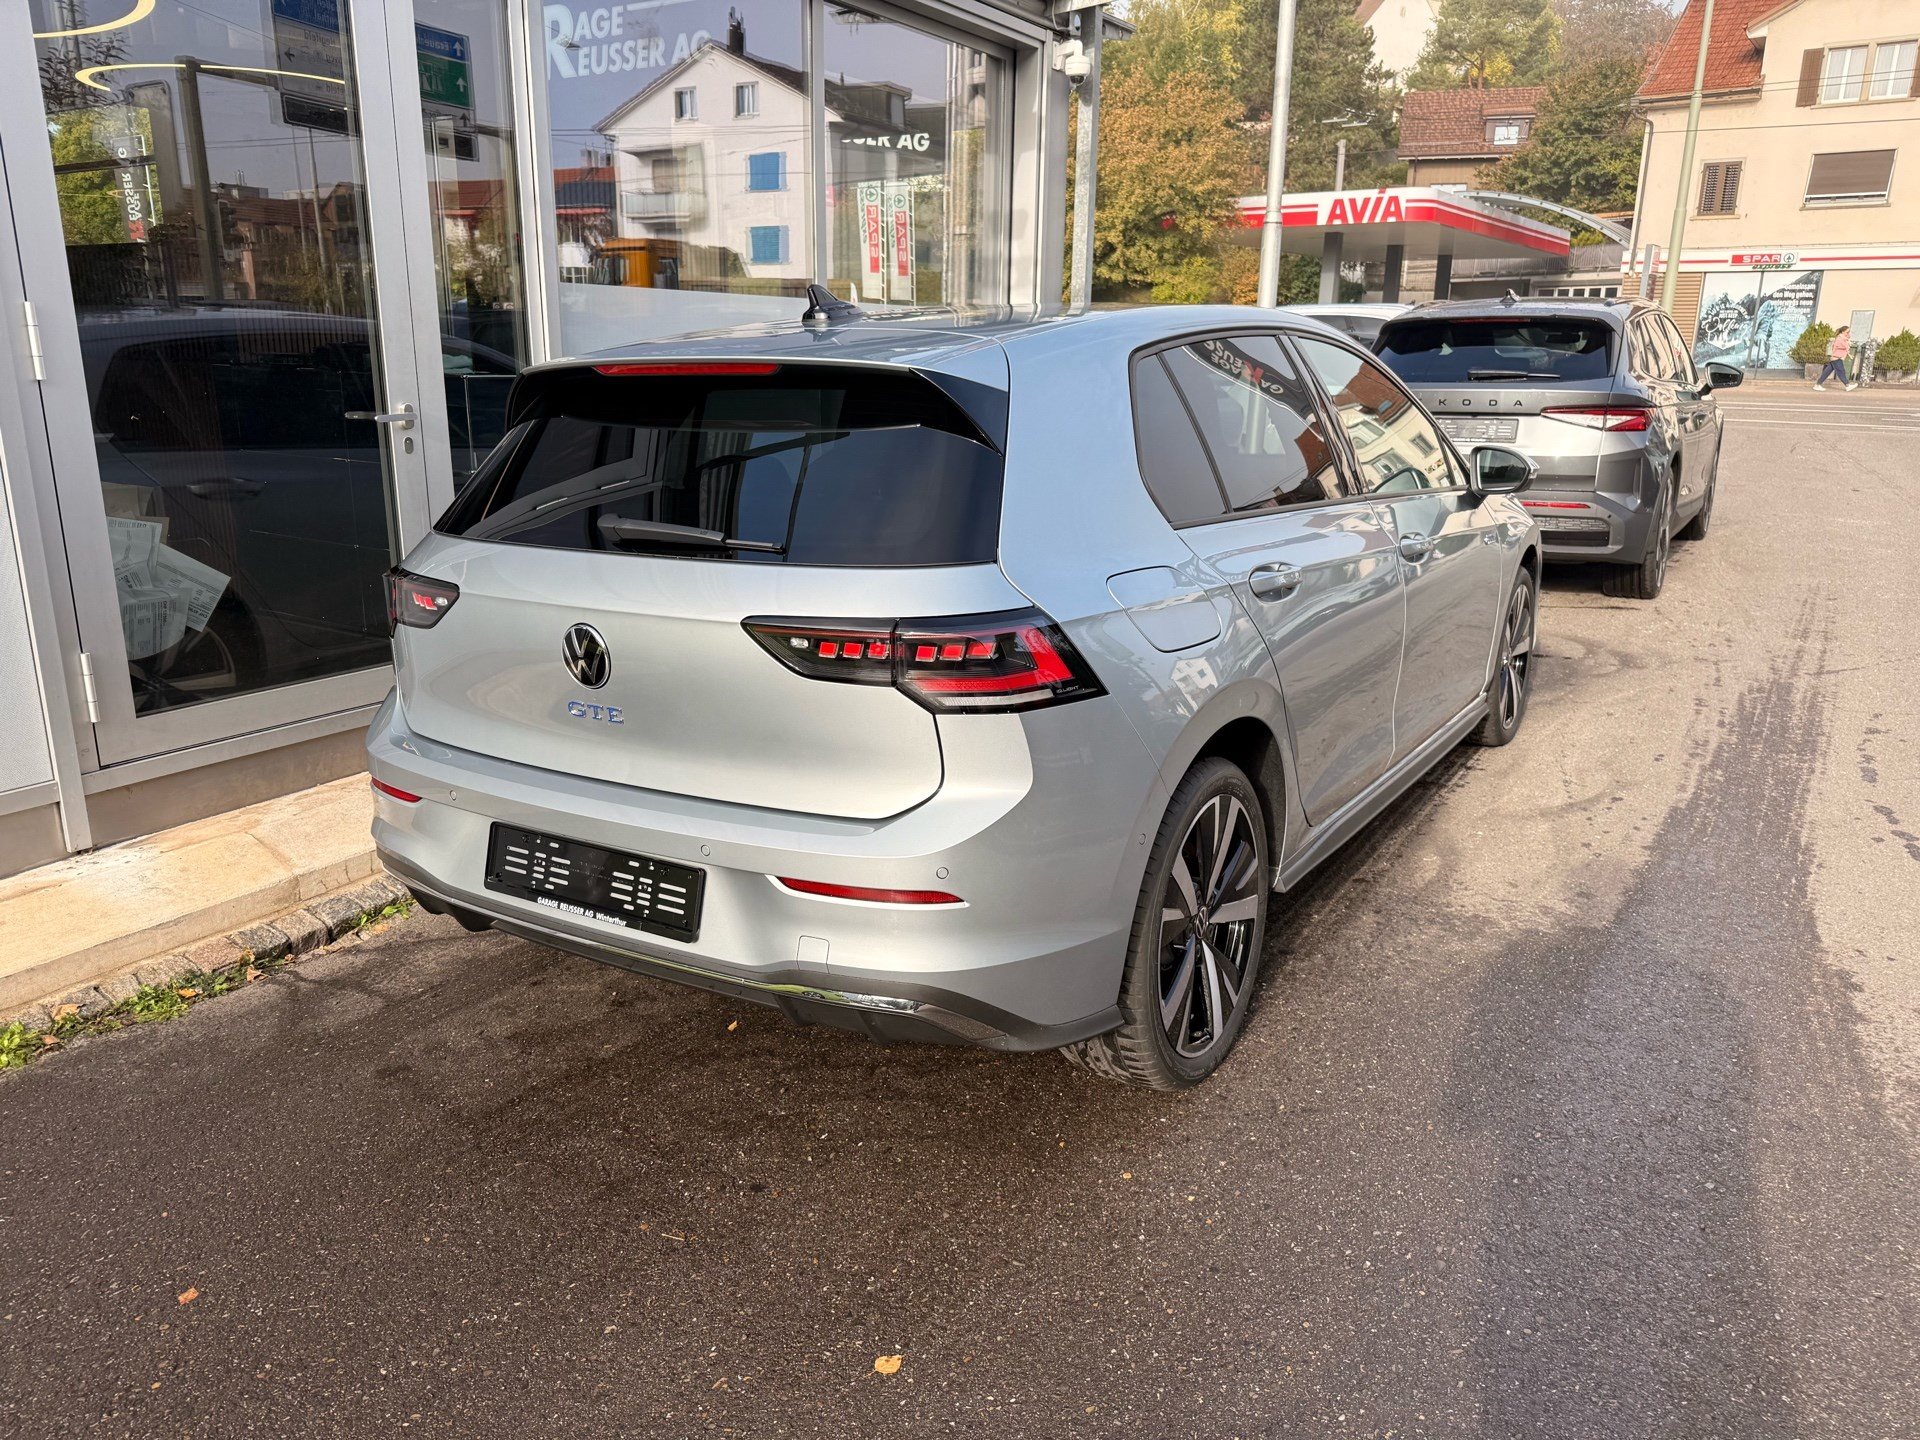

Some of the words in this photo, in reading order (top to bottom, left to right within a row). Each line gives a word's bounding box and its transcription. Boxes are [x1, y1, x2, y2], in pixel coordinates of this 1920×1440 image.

[897, 132, 930, 151] AG
[1742, 254, 1780, 263] SPAR
[1420, 398, 1523, 408] KODA
[567, 700, 625, 725] GTE
[537, 896, 559, 910] GARAGE
[560, 902, 585, 916] REUSSER
[585, 909, 594, 918] AG
[596, 911, 628, 927] Winterthur
